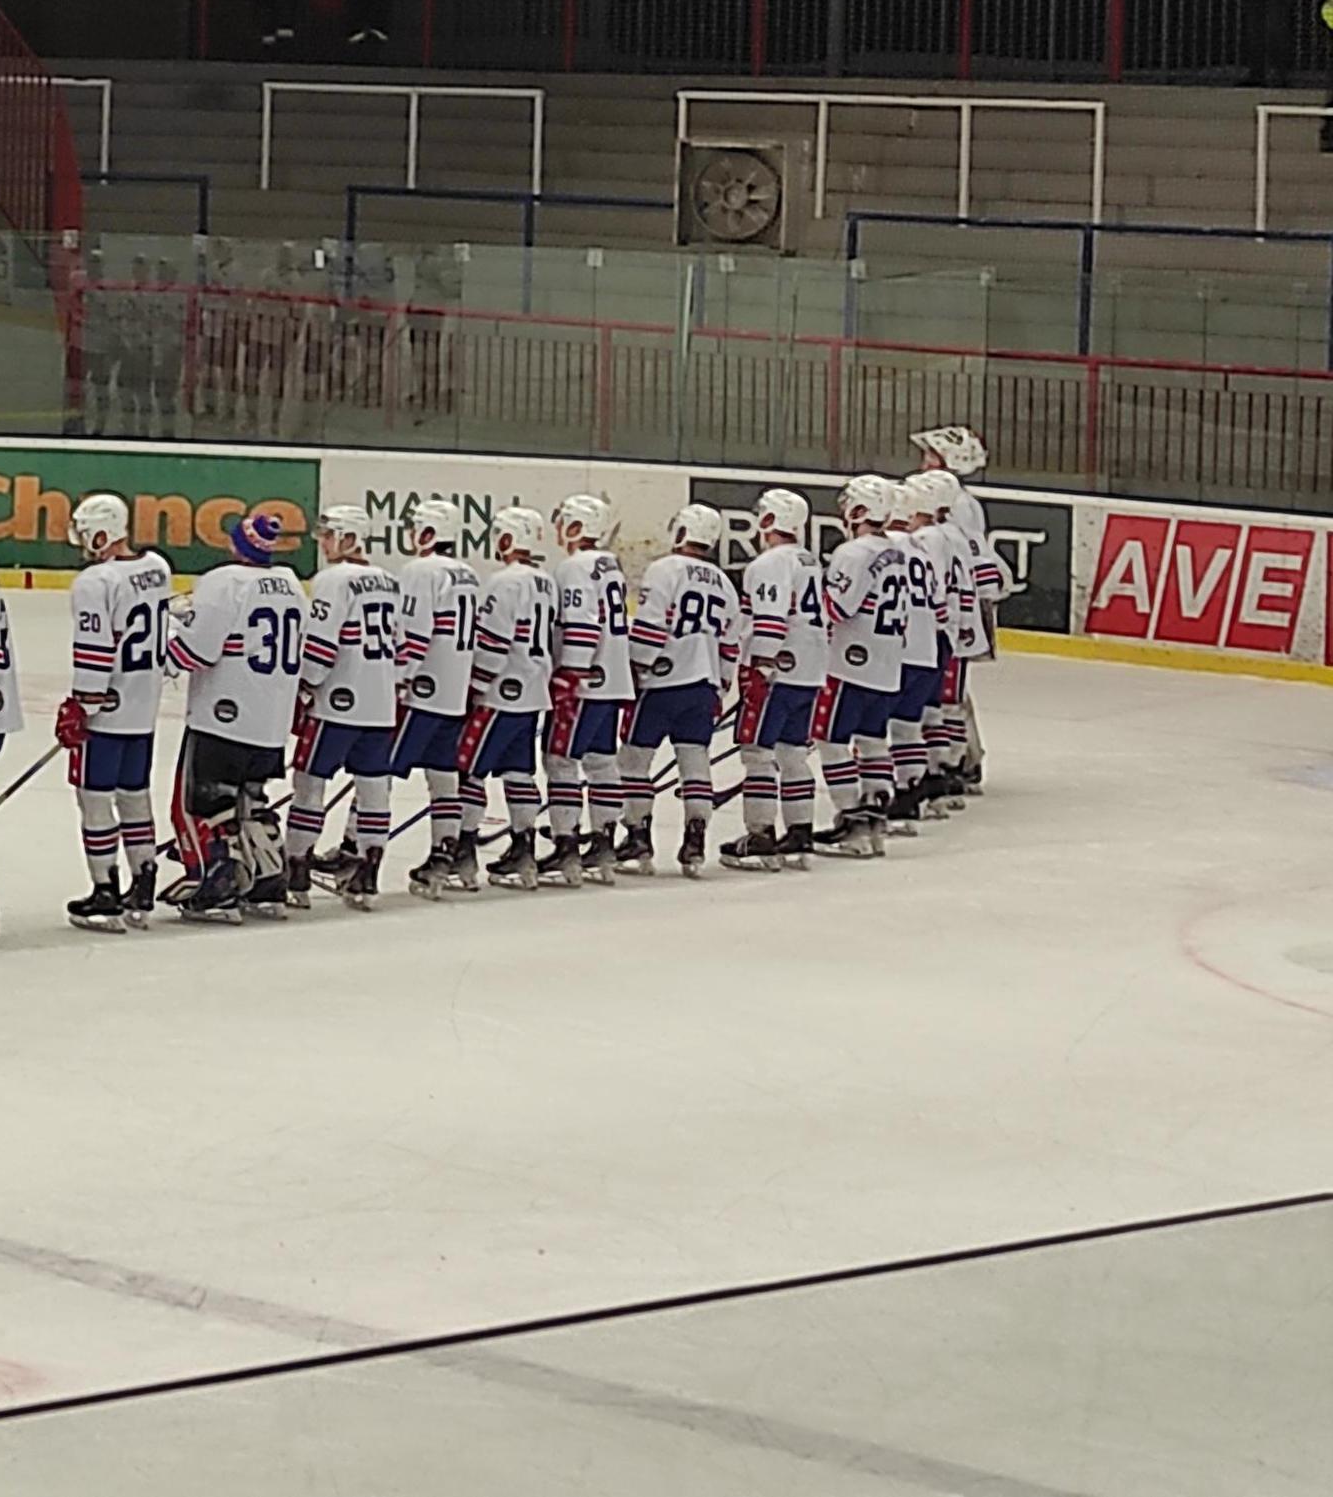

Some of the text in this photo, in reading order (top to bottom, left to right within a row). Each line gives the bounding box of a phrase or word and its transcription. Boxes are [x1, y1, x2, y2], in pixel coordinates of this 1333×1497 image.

[755, 583, 778, 603] 44
[1092, 540, 1304, 629] AVE
[78, 610, 101, 634] 20
[121, 598, 170, 673] 20
[247, 606, 302, 676] 30
[673, 590, 726, 640] 85
